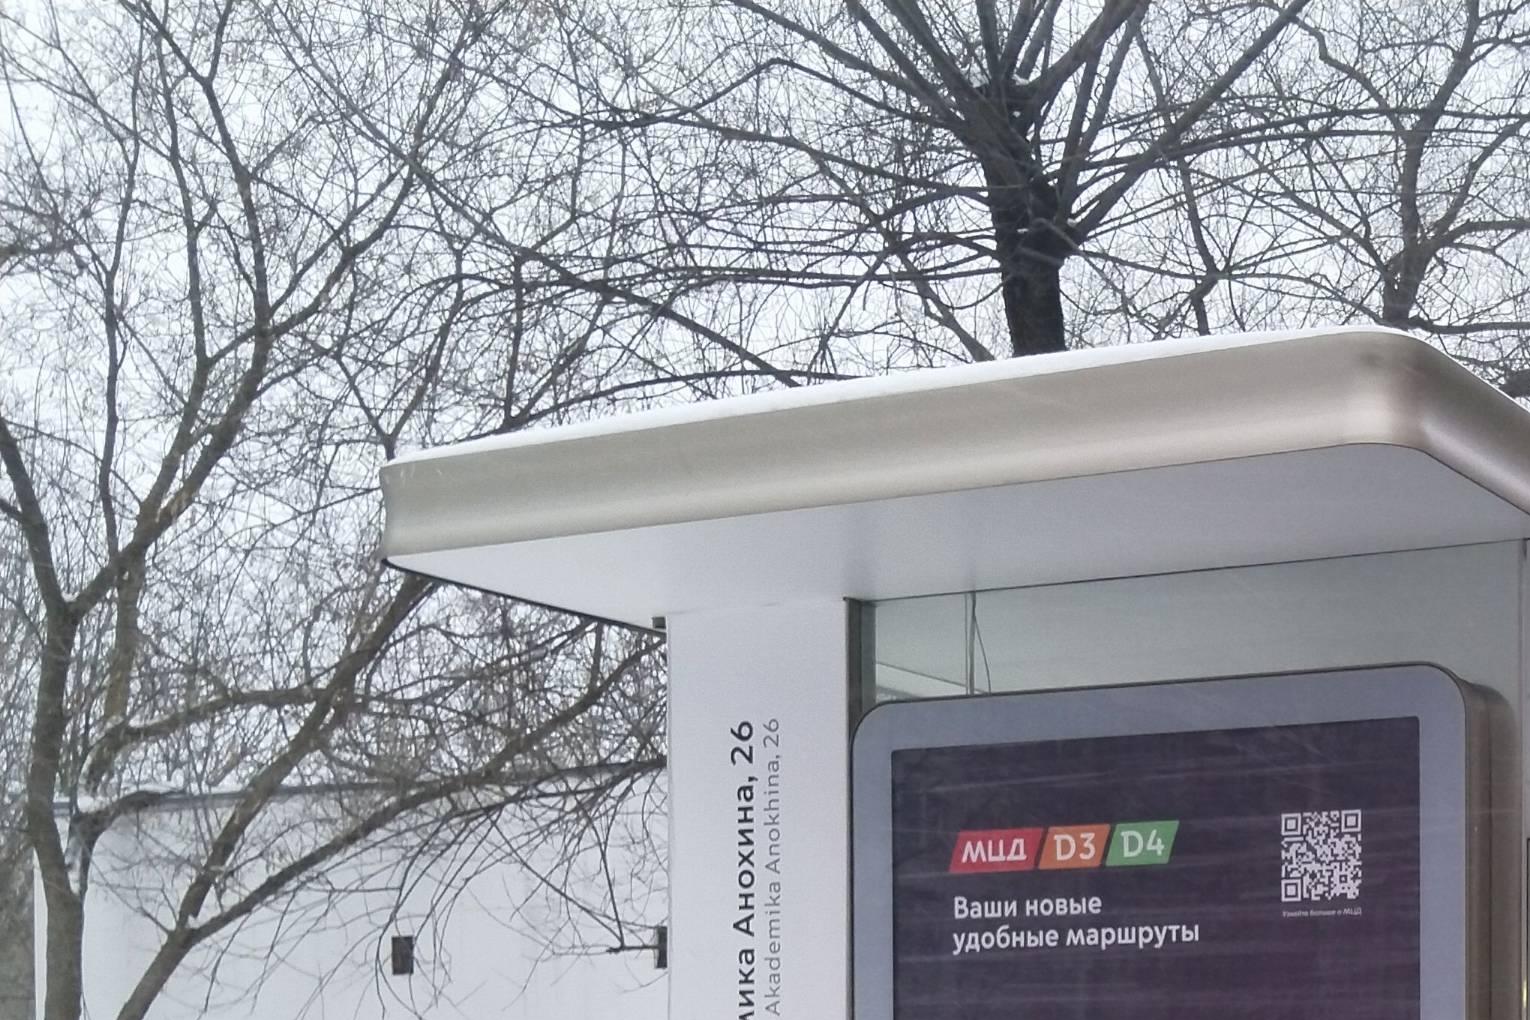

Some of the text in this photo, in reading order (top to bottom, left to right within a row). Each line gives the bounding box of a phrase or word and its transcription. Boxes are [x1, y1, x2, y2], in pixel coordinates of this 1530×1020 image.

[730, 721, 754, 766] 26
[763, 718, 780, 748] 26
[763, 754, 781, 874] Anokhina,
[732, 776, 758, 937] Анохина,
[961, 829, 1165, 863] МЦД D3 D4
[953, 896, 1102, 919] Ваши новые
[763, 881, 782, 1016] Akademika
[952, 924, 1200, 955] удобные маршруты
